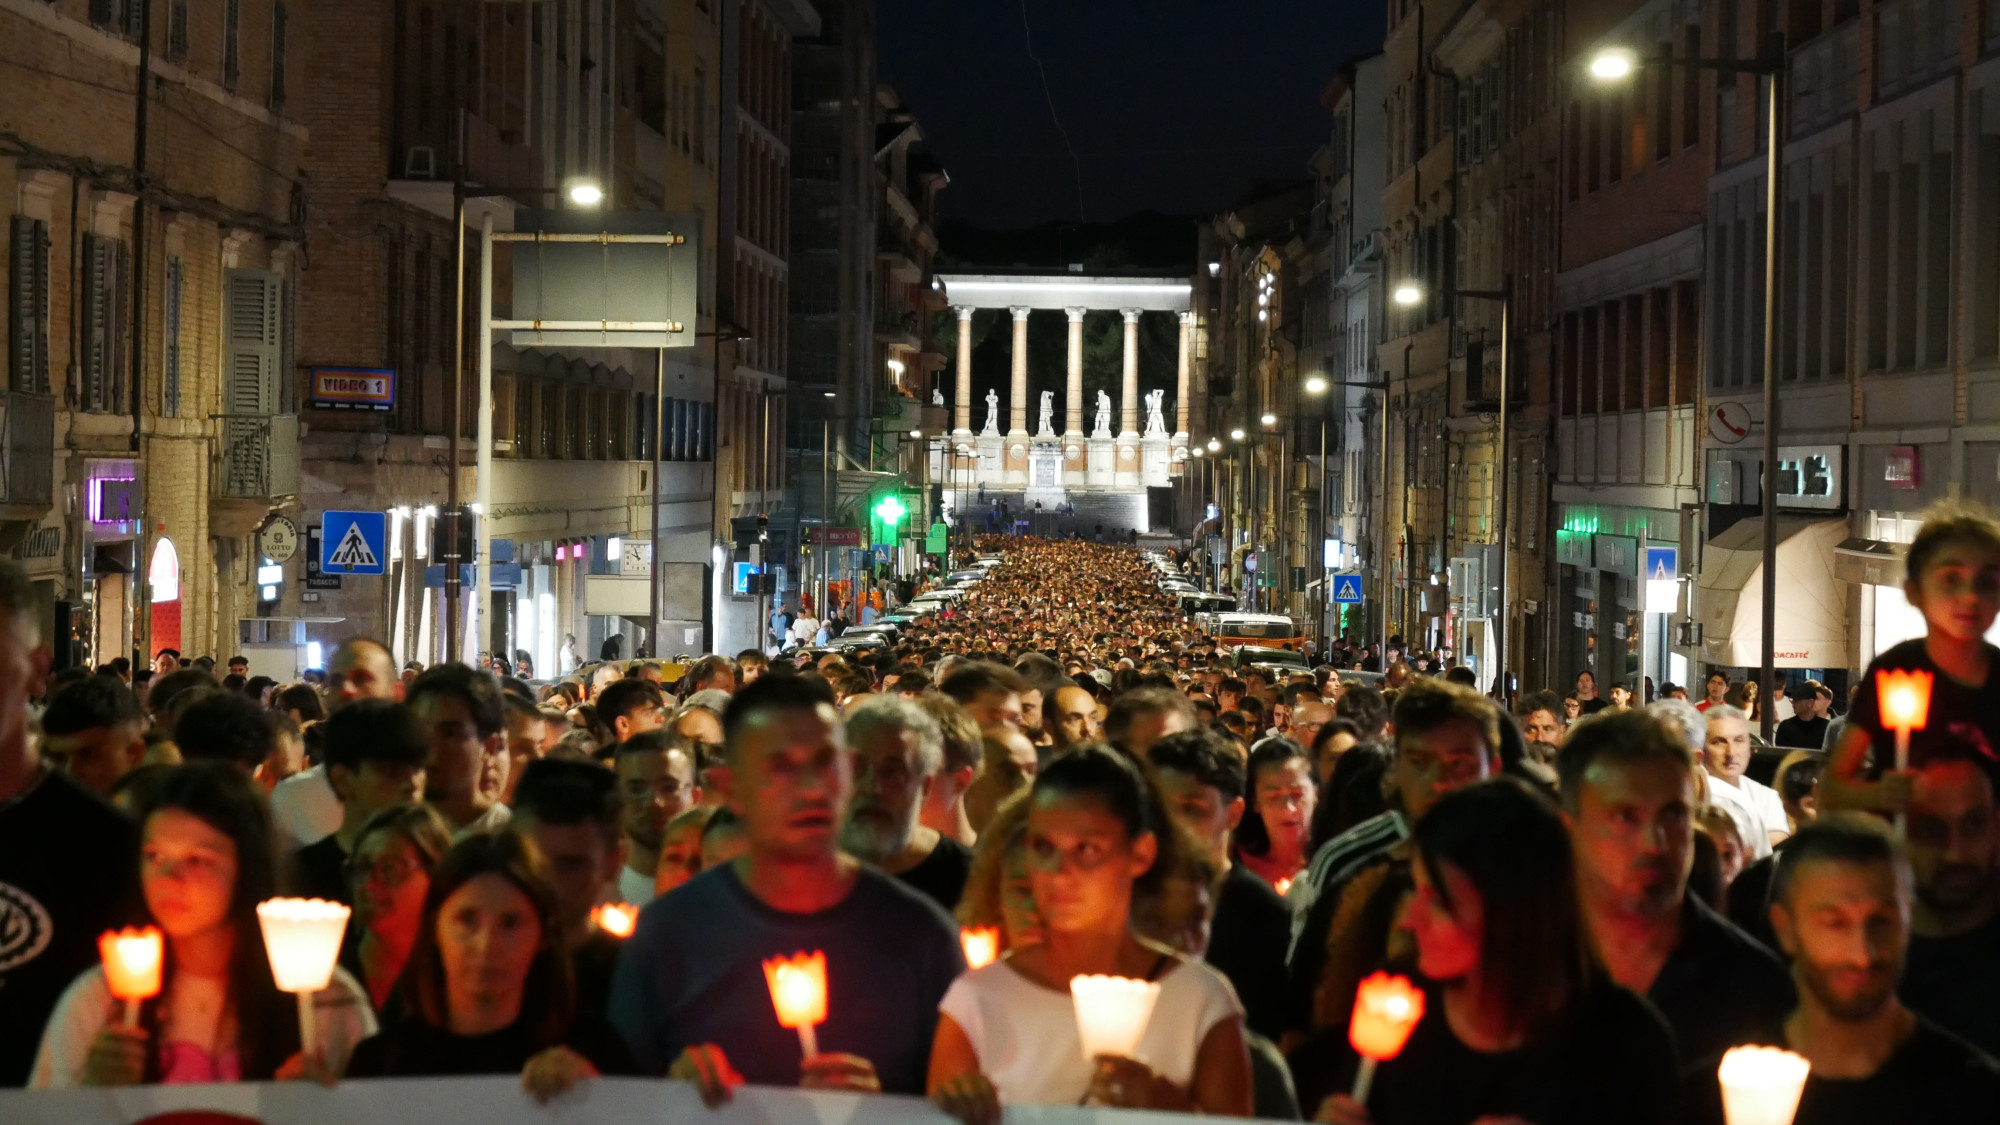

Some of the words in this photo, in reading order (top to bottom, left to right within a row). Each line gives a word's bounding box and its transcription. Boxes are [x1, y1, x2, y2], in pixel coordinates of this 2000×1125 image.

[324, 378, 369, 393] VIDEO
[375, 380, 384, 394] 1
[309, 578, 339, 586] TABACCHI
